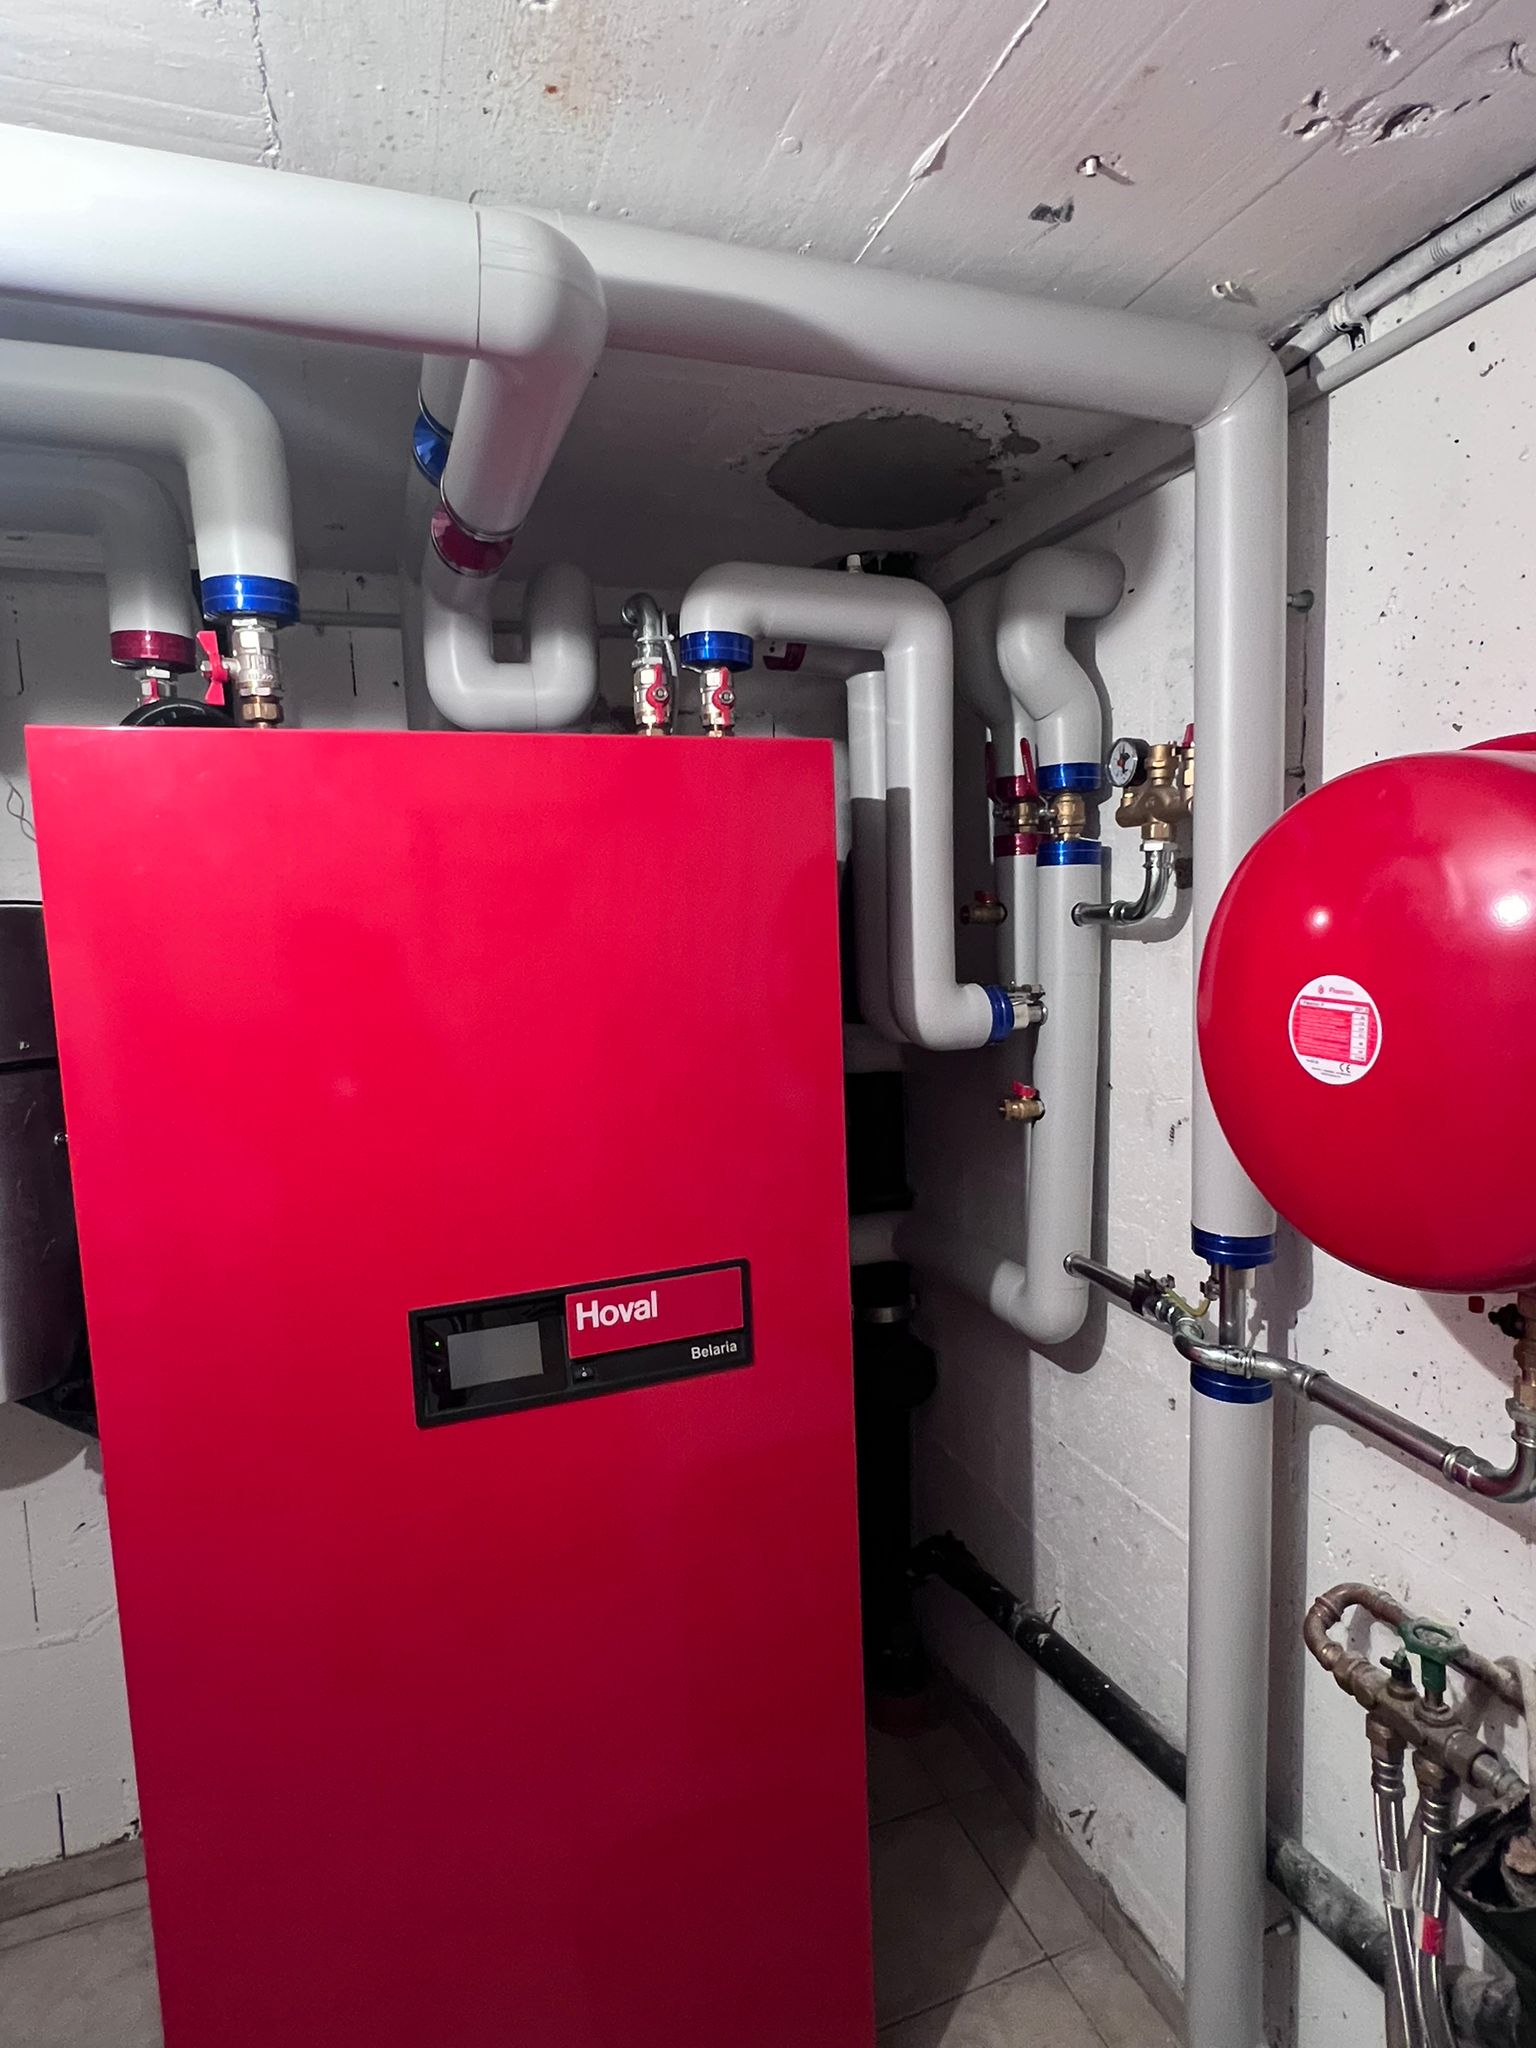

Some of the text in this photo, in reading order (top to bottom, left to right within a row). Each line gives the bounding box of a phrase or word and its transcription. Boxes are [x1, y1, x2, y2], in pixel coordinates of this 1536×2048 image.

[1339, 1063, 1351, 1073] CE
[576, 1290, 658, 1331] Hoval
[691, 1341, 737, 1360] Belaria
